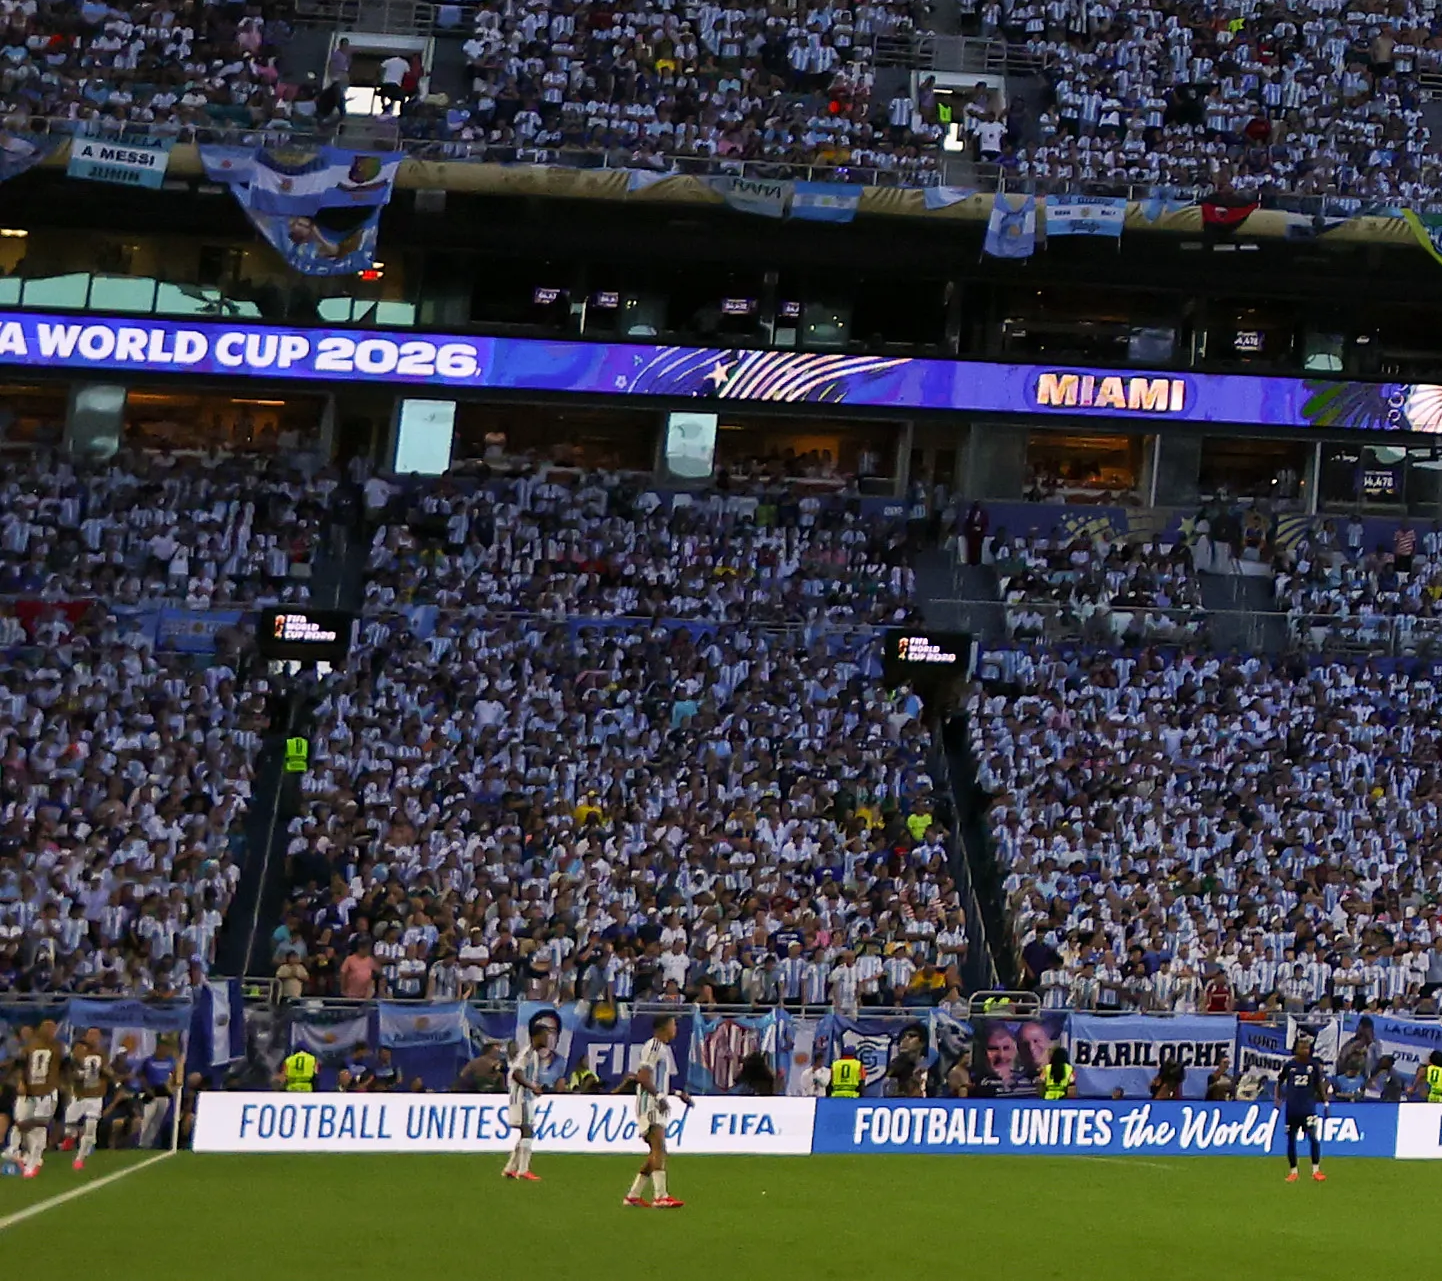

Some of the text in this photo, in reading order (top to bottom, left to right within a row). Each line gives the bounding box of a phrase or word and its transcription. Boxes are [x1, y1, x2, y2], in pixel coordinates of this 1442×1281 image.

[82, 145, 156, 166] A MESSI
[38, 324, 478, 378] WORLD CUP 2026
[1037, 373, 1185, 412] MIAMI
[1294, 1074, 1309, 1086] 22
[240, 1103, 393, 1140] FOOTBALL
[405, 1104, 510, 1140] UNITES
[710, 1113, 776, 1136] FIFA
[853, 1102, 1280, 1153] FOOTBALL UNITES the World
